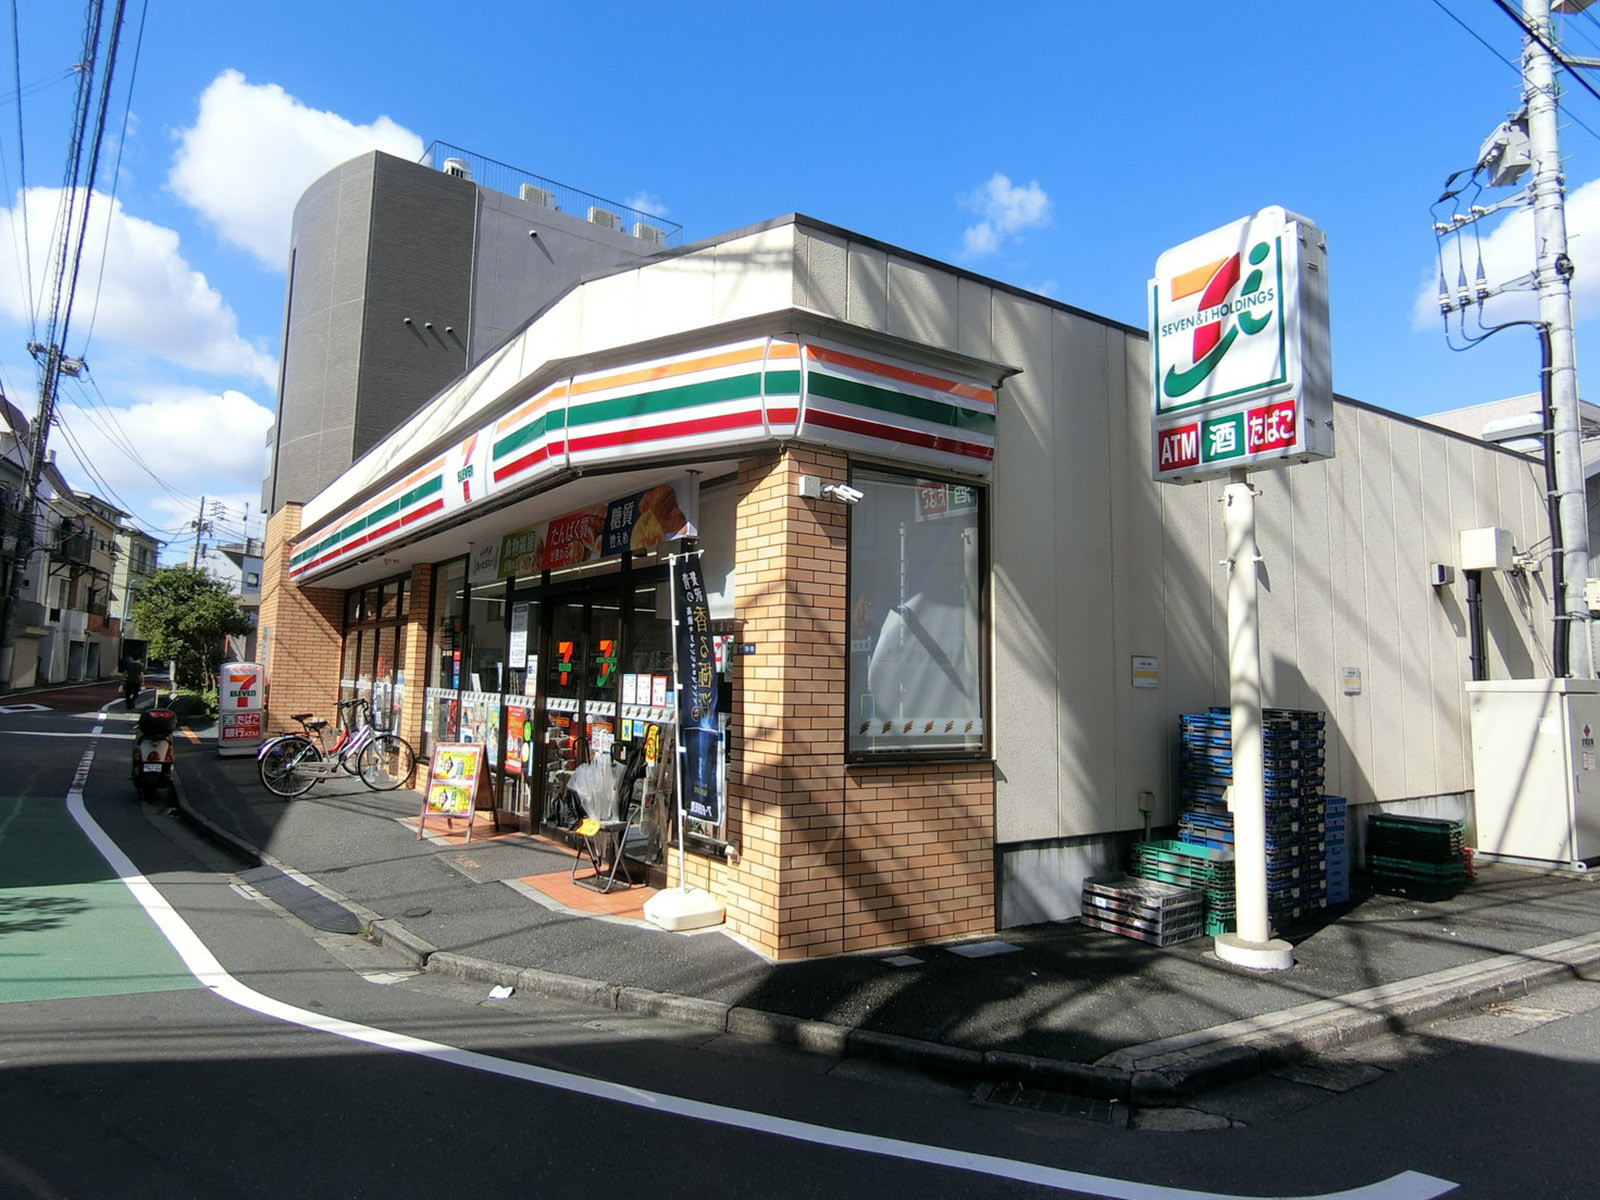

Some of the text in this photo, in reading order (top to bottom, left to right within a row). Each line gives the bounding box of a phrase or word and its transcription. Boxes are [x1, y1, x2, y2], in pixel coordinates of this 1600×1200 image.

[1211, 288, 1274, 320] HOLDINGS
[1161, 431, 1197, 465] ATM
[1209, 409, 1294, 457] 酒 たばこ
[611, 501, 634, 531] 糖質
[610, 531, 629, 549] 控えめ
[236, 713, 259, 725] たばこ
